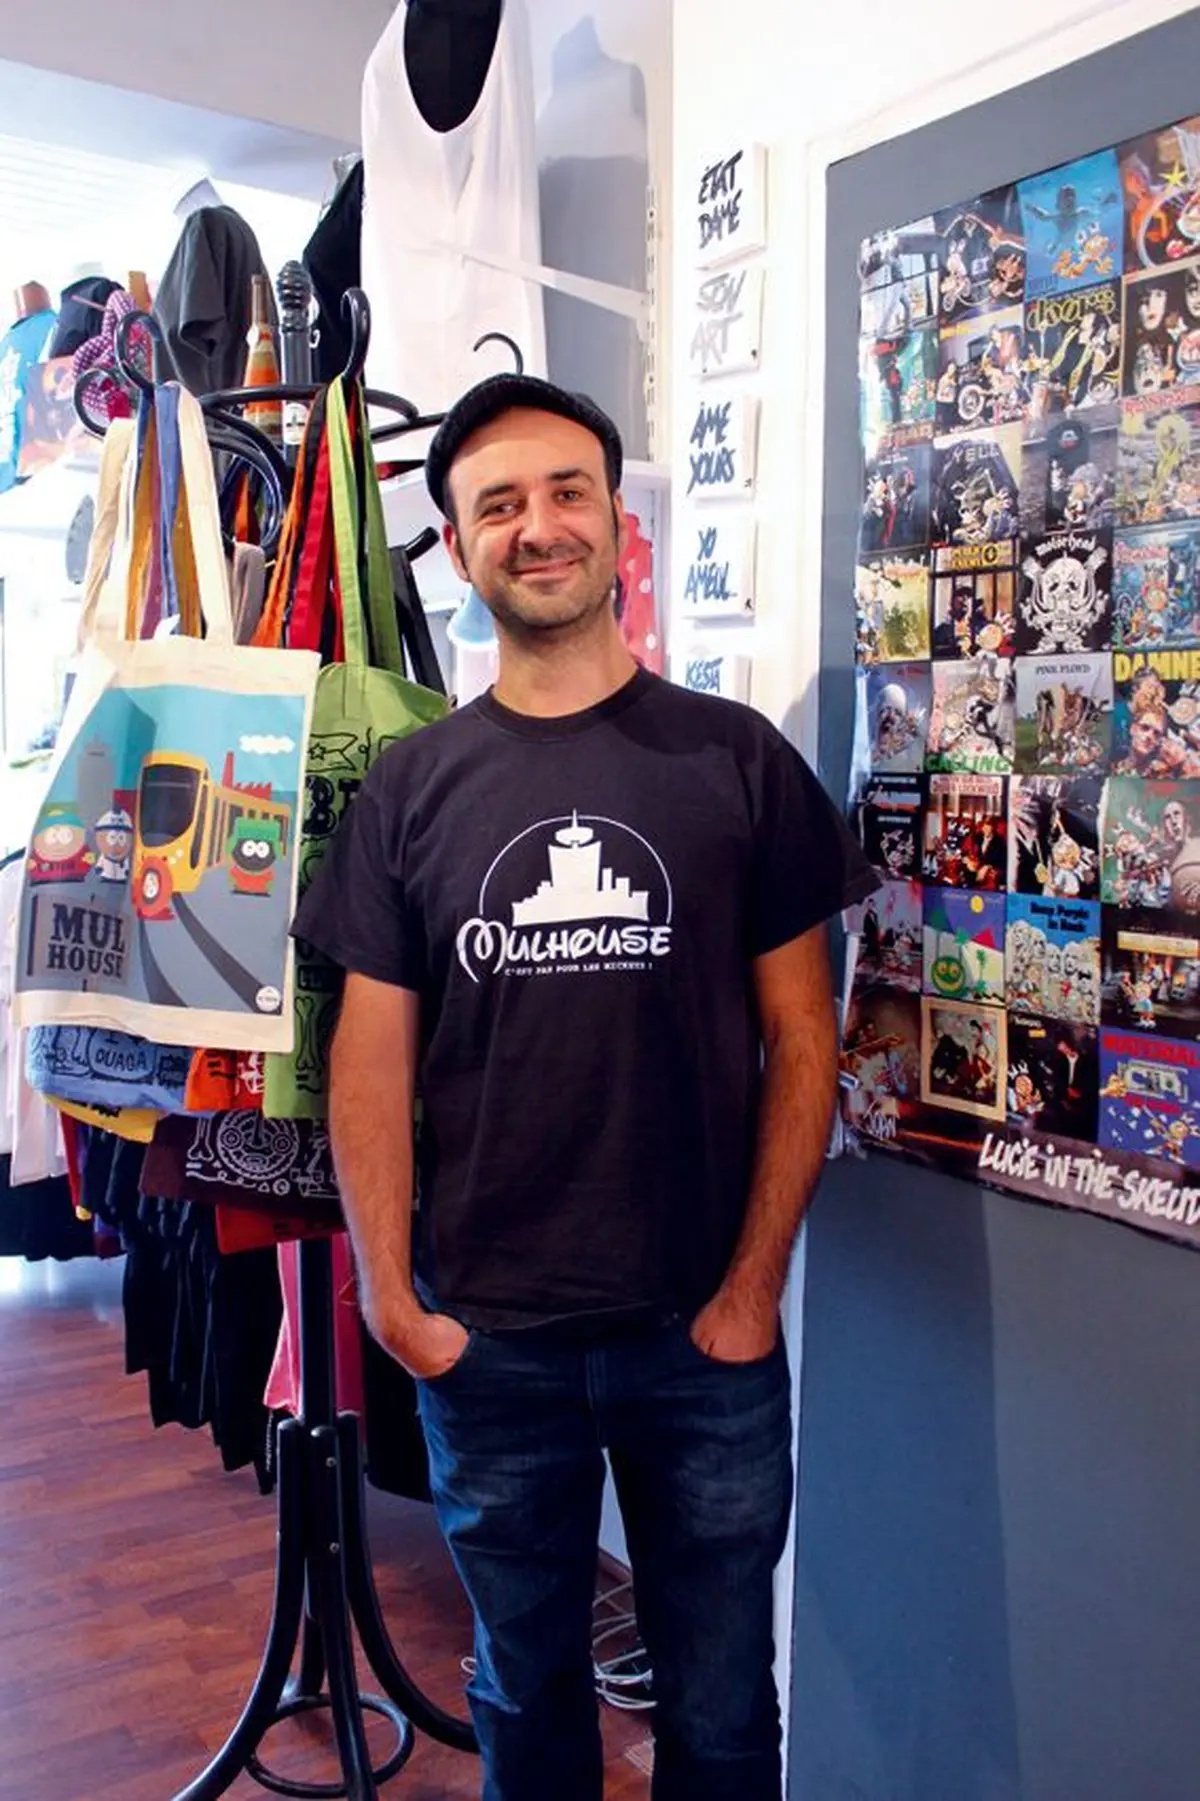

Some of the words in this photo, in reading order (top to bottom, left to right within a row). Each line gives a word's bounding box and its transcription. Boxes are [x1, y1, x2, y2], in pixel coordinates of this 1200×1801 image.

[1035, 664, 1058, 675] PINK
[1060, 663, 1091, 674] FLOYD
[50, 903, 125, 953] MUL
[556, 964, 580, 973] POUR
